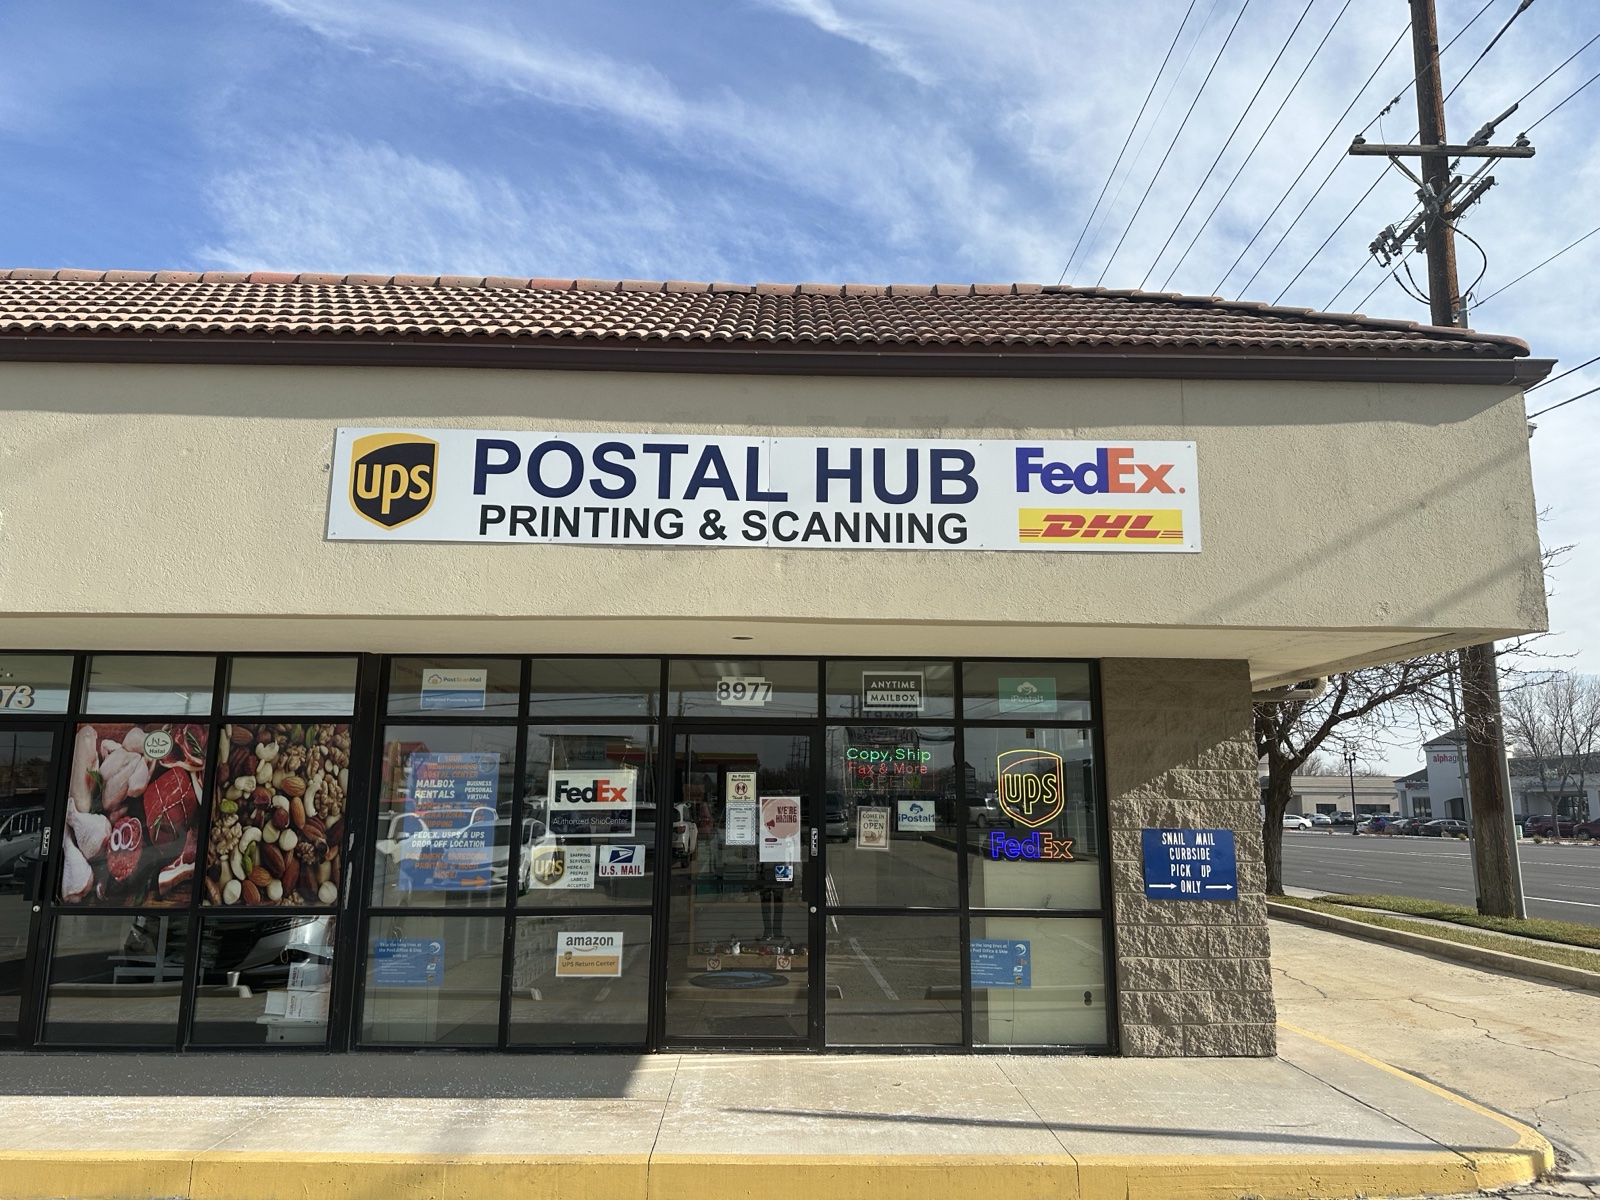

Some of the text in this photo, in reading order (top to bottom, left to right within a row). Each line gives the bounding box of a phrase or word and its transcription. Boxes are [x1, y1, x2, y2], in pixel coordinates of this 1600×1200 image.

[473, 439, 979, 505] POSTAL HUB
[357, 463, 430, 514] ups
[479, 504, 968, 544] PRINTING & SCANNING
[1043, 515, 1161, 539] DHL
[717, 681, 772, 701] 8977
[870, 681, 915, 689] ANYTIME
[870, 694, 915, 702] MAILBOX
[1010, 694, 1044, 703] iPostal1
[147, 737, 169, 747] حلال
[846, 747, 931, 763] Copy, Ship
[848, 762, 928, 774] Fax & More
[416, 779, 455, 788] MAILBOX
[862, 775, 914, 788] OPEN
[414, 790, 455, 799] RENTALS
[554, 780, 627, 803] FedEx
[1004, 773, 1057, 815] ups
[777, 806, 797, 814] WE'RE
[552, 817, 628, 826] Authorized ShipCenter
[776, 815, 797, 823] HIRING
[898, 813, 935, 822] iPostal1
[413, 831, 440, 839] FEDEX,
[1161, 832, 1215, 845] SNAIL MAIL
[411, 840, 485, 848] DROP OFF LOCATION
[991, 831, 1073, 859] FedEx
[1169, 847, 1210, 860] CURBSIDE
[534, 859, 563, 880] ups
[601, 865, 642, 875] U.S. MAIL
[1170, 864, 1211, 877] PICK UP
[1180, 880, 1201, 893] ONLY
[566, 936, 614, 946] amazon
